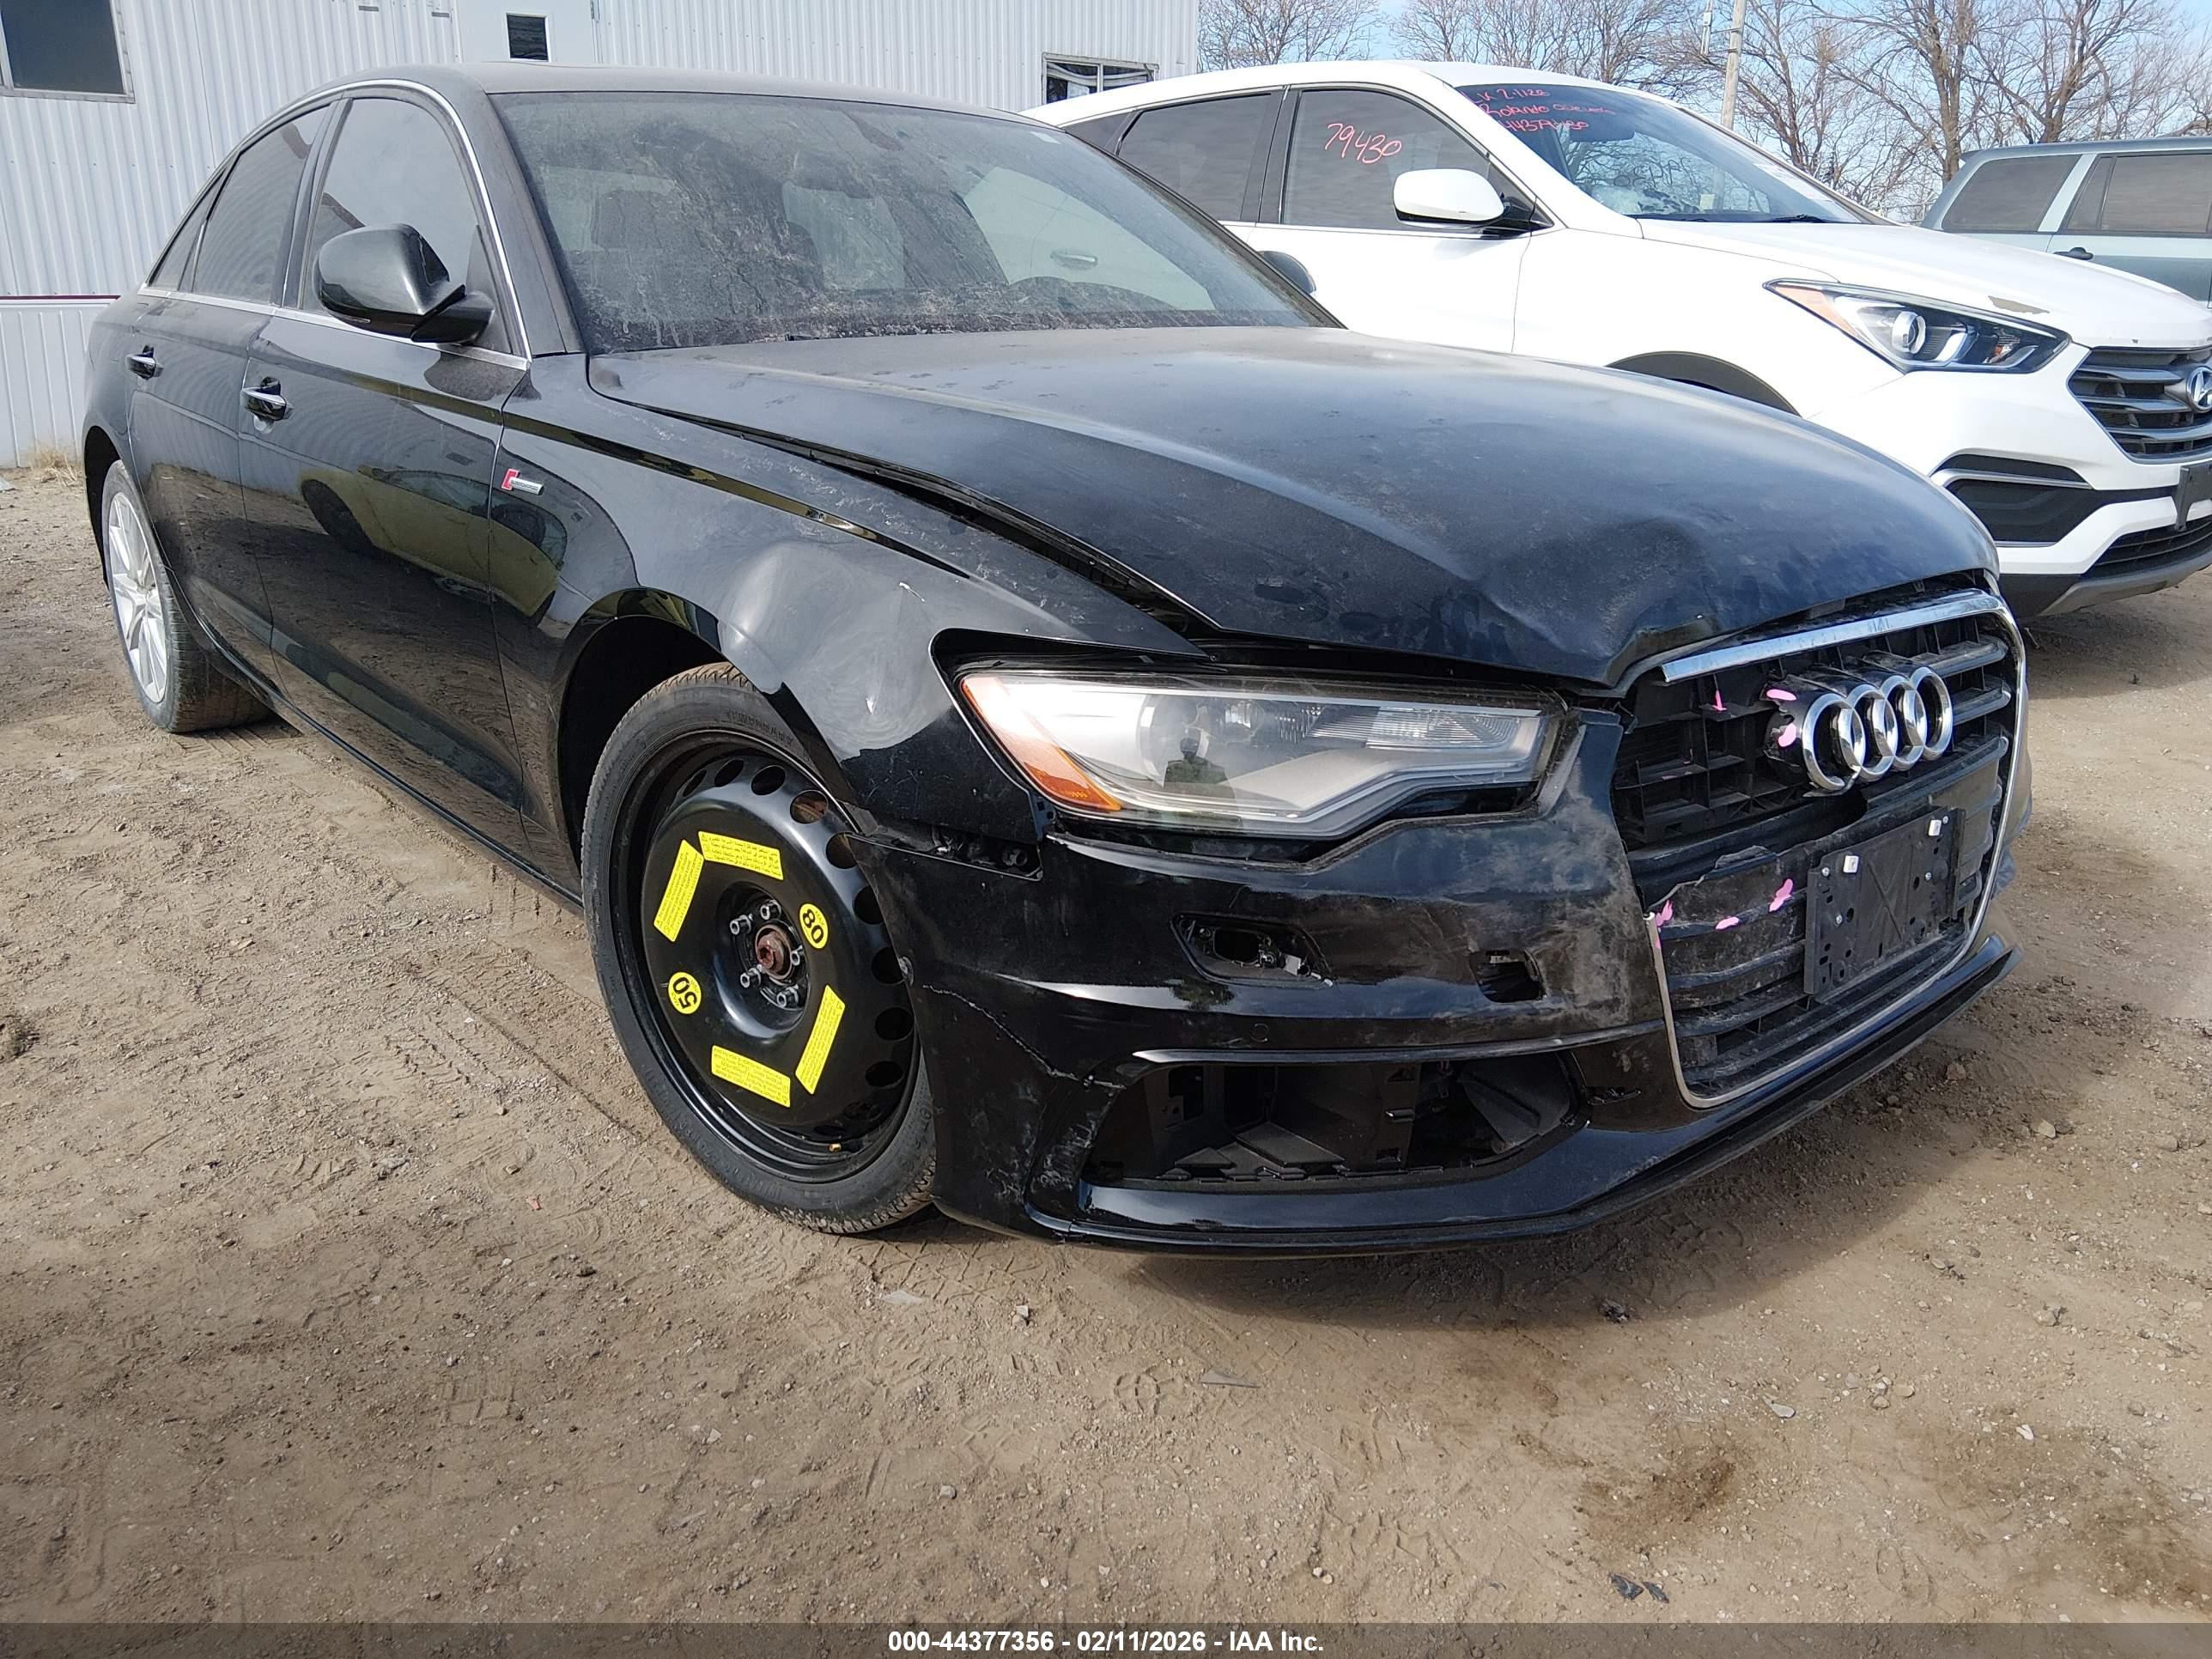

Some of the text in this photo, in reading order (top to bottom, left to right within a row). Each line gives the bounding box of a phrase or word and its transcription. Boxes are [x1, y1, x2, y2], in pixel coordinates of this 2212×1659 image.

[1324, 123, 1402, 164] 79430
[802, 908, 824, 945] 80
[672, 976, 697, 1010] 50
